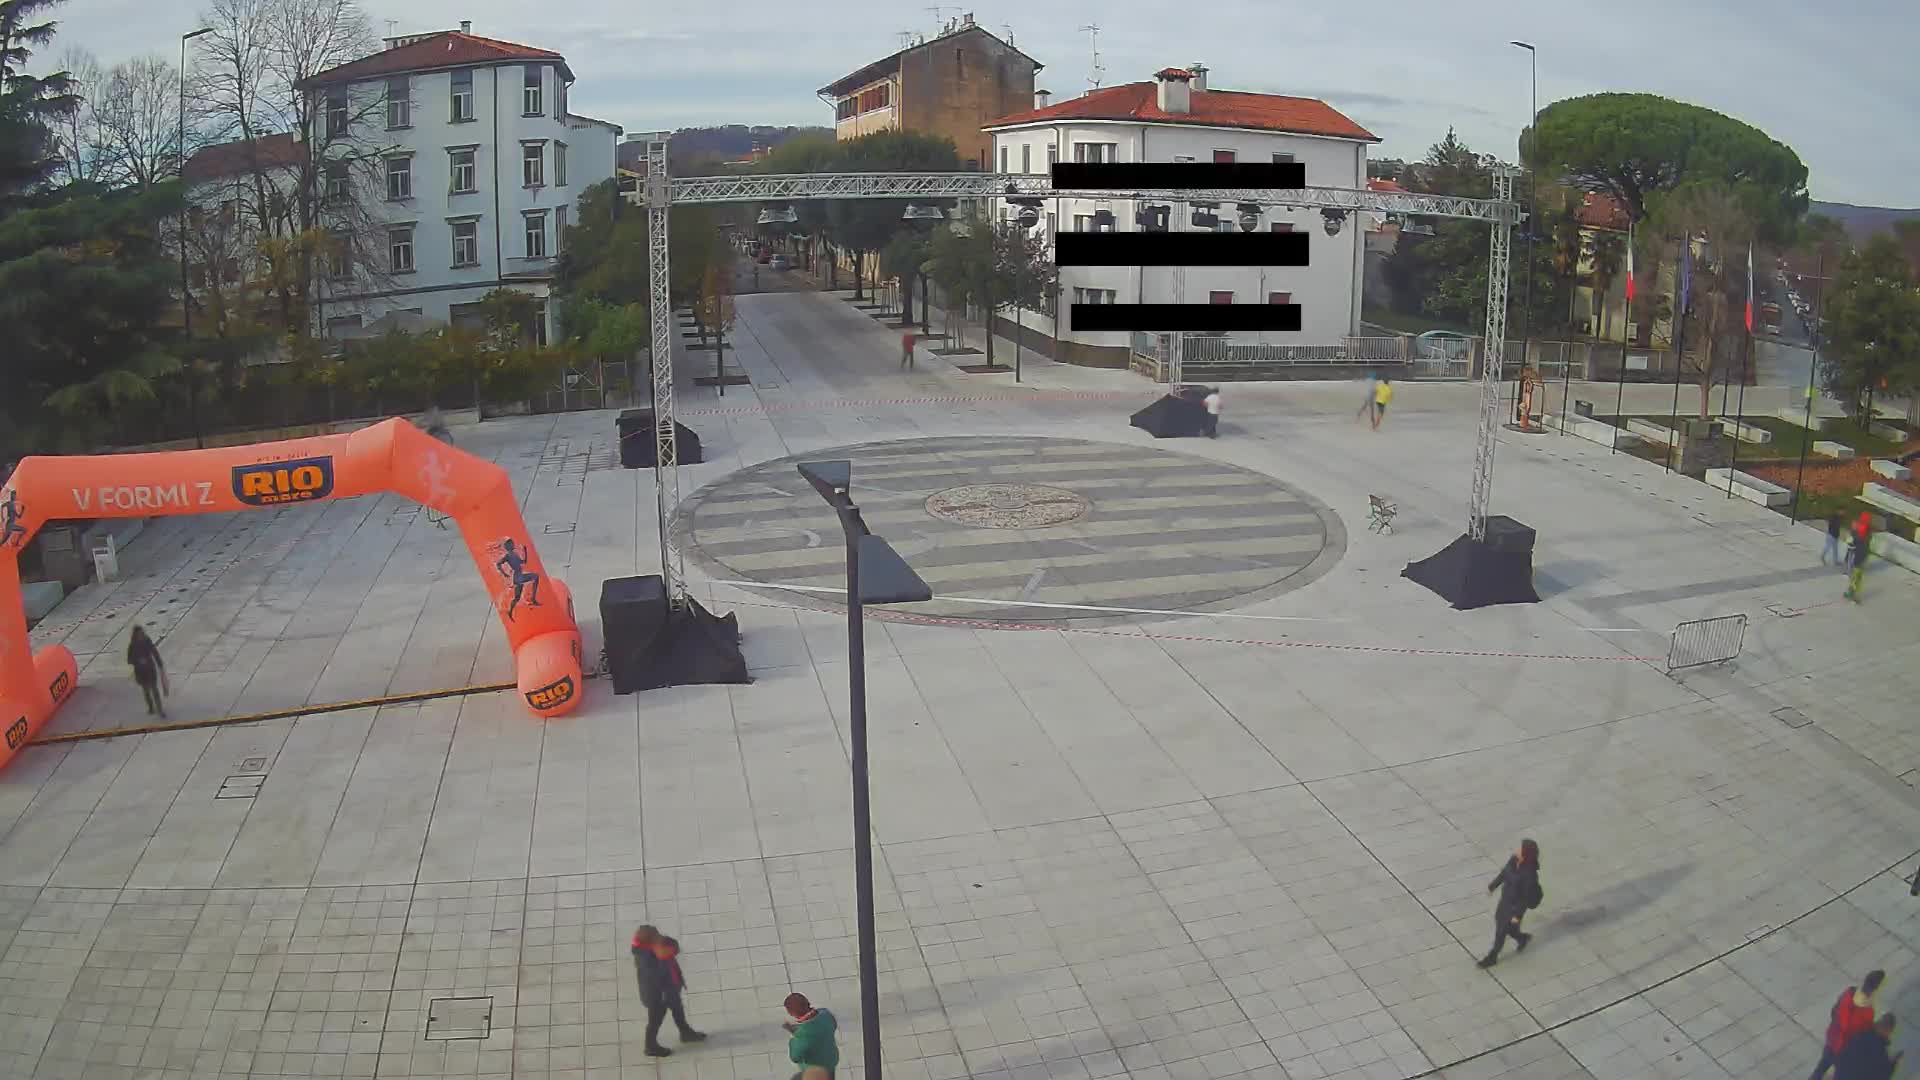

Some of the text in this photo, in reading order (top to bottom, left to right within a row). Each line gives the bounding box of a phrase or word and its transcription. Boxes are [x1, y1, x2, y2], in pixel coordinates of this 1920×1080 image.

[72, 481, 216, 512] V FORMI Z
[241, 465, 324, 497] RIO
[530, 682, 570, 706] RIO
